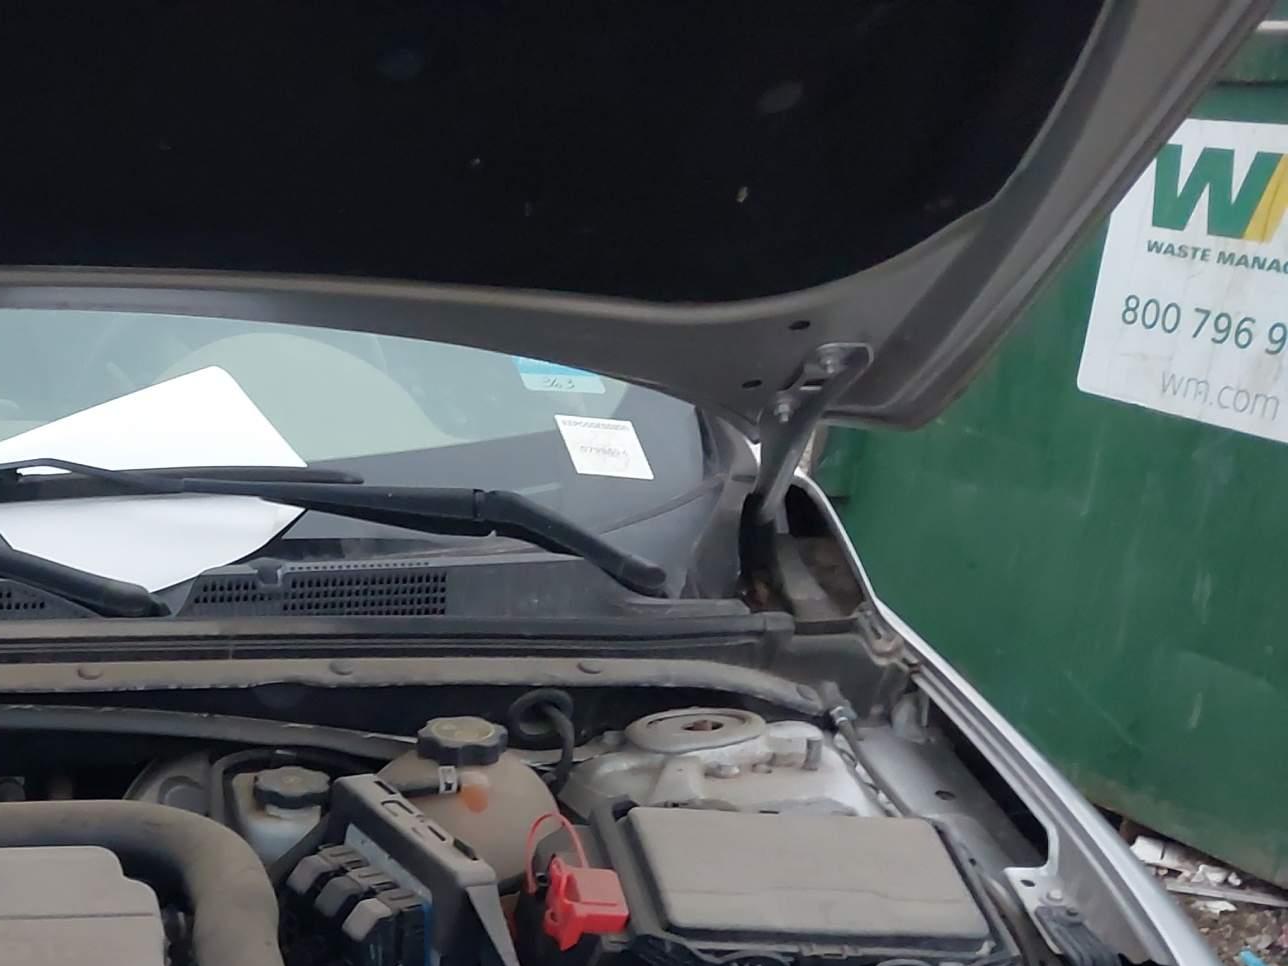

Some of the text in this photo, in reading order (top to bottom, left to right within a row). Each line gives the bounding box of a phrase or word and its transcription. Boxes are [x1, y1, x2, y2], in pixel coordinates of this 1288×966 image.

[1147, 240, 1211, 262] WASTE
[1122, 295, 1181, 334] 800
[1192, 307, 1256, 349] 796
[1161, 371, 1280, 421] wm.com
